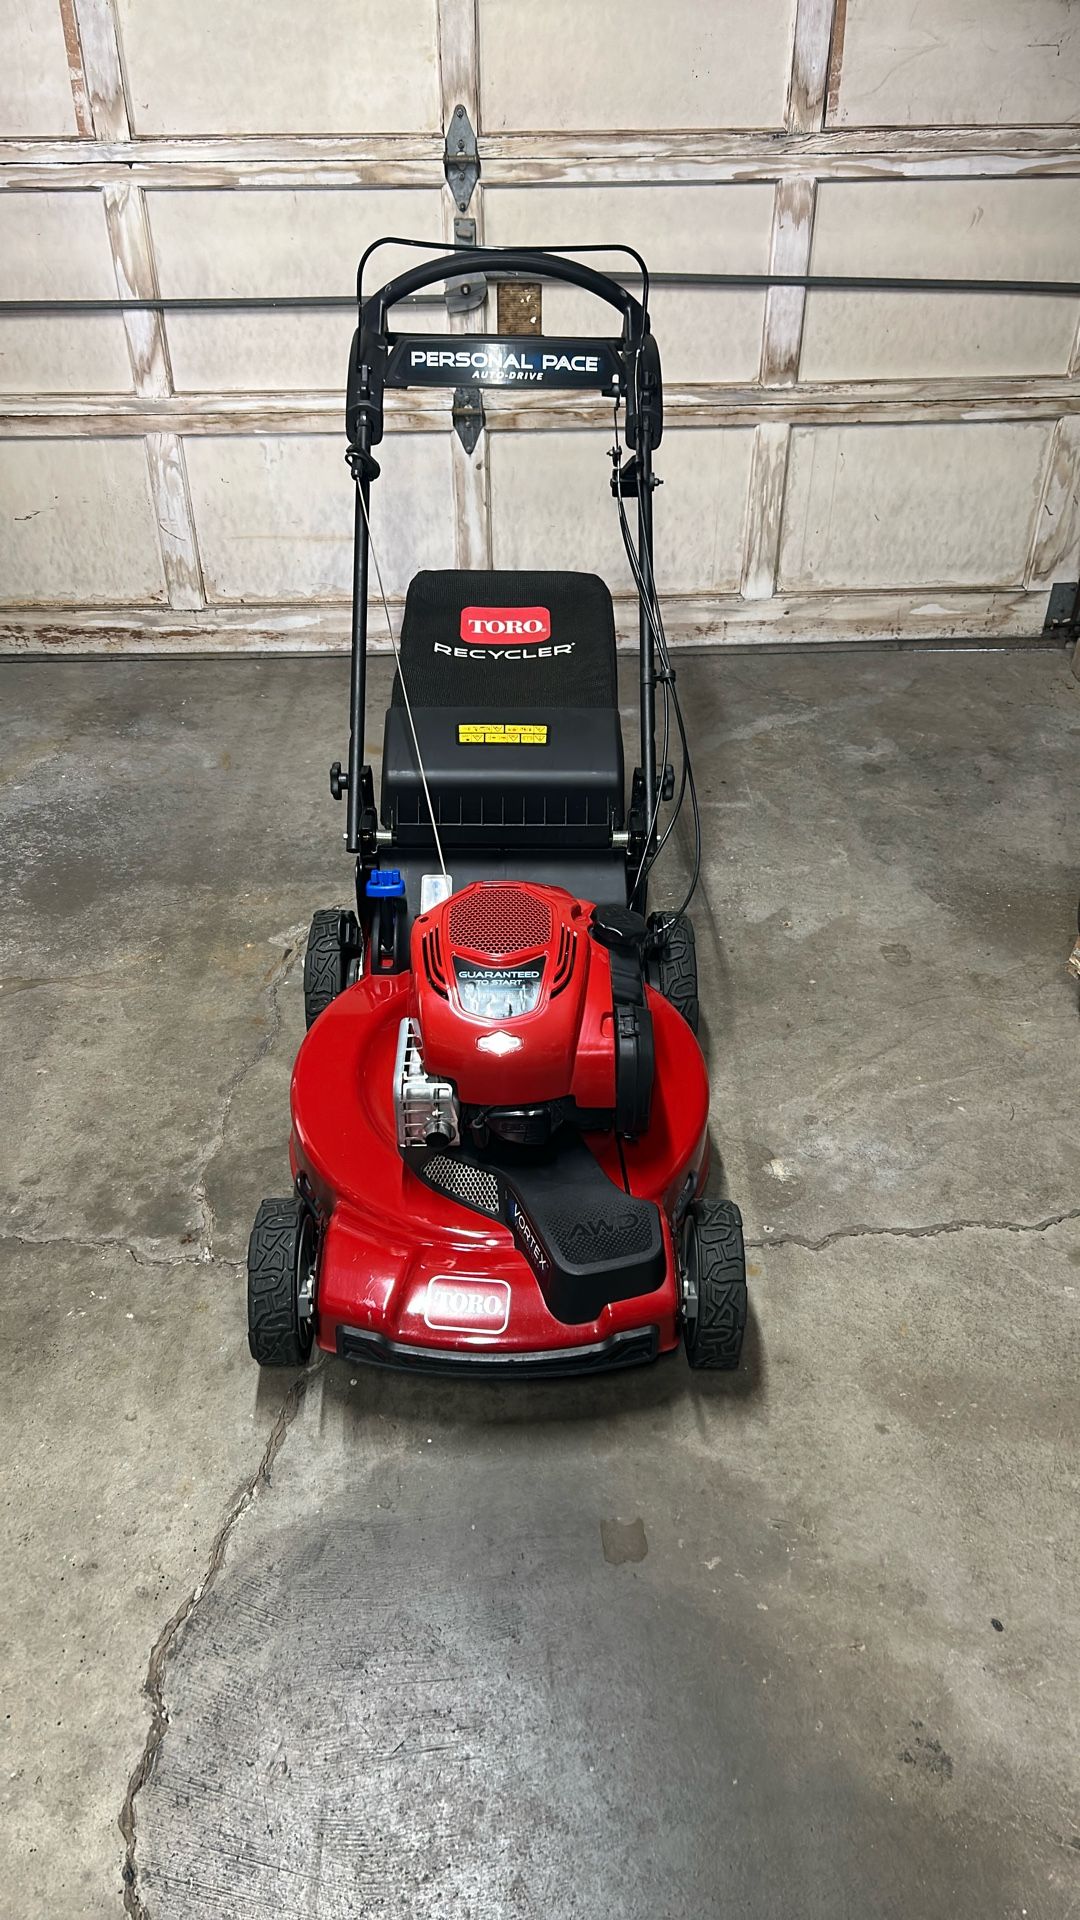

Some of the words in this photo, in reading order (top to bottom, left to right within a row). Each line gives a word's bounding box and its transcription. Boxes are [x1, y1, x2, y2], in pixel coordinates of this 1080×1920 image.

[411, 351, 533, 370] PERSONAL
[542, 354, 599, 372] PACE
[472, 370, 544, 381] AUTO-DRIVE
[433, 642, 573, 660] RECYCLER
[514, 1203, 547, 1270] VORTEX
